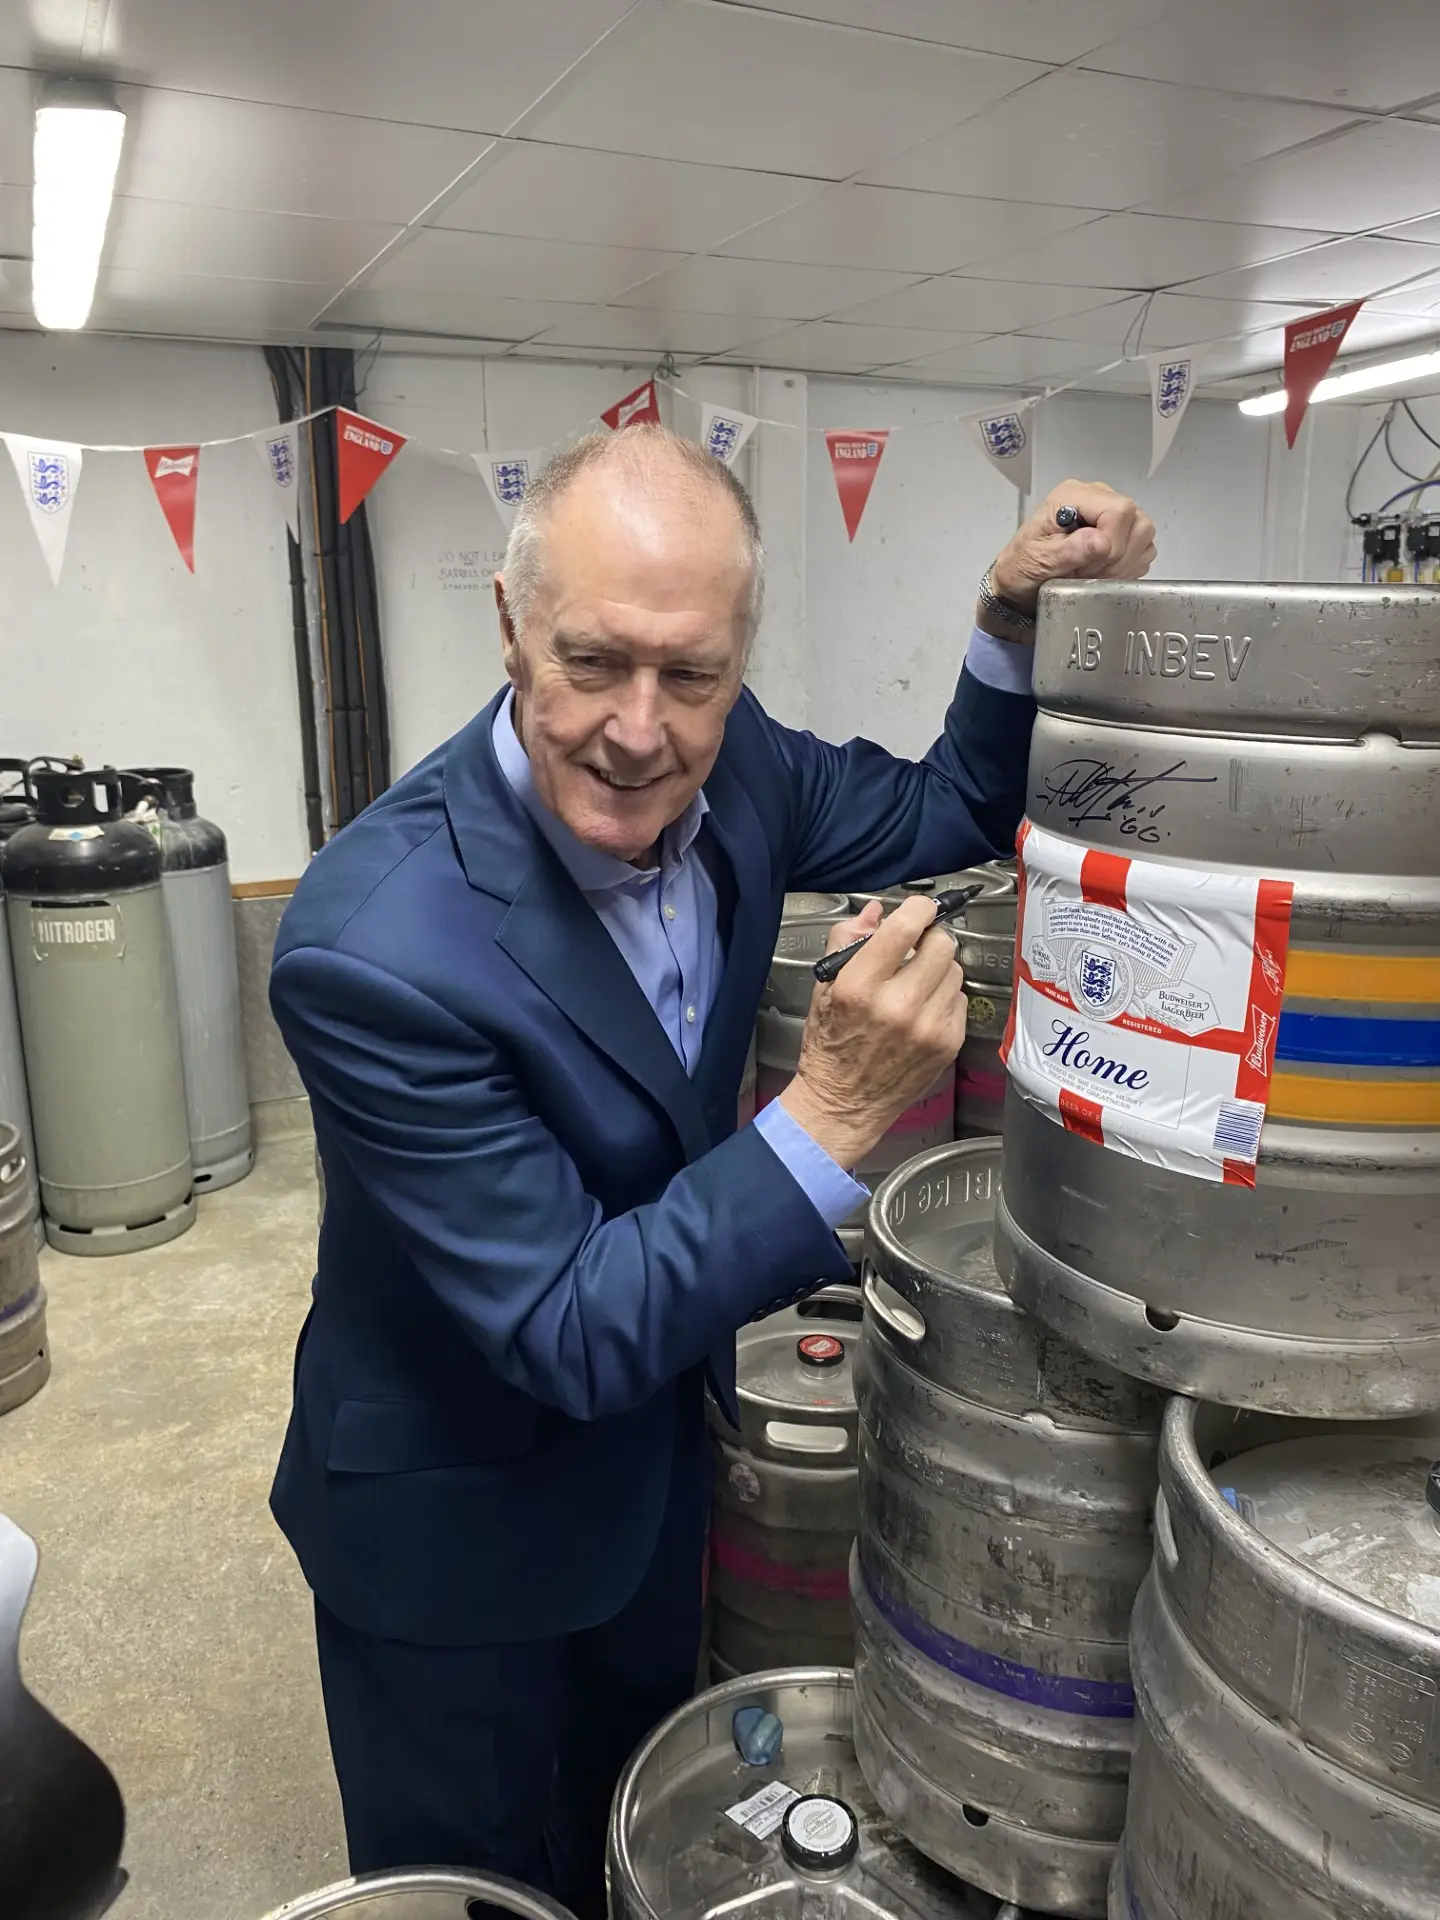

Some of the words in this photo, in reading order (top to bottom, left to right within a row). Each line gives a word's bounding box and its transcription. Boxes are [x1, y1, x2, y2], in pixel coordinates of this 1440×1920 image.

[1290, 329, 1330, 352] ENGLAND
[344, 429, 380, 452] ENGLAND
[459, 551, 479, 562] NOT
[1067, 627, 1102, 672] AB
[1124, 630, 1252, 682] INBEV
[38, 918, 116, 944] NITROGEN
[1094, 910, 1112, 920] blessed
[1112, 916, 1123, 924] this
[1123, 920, 1153, 937] Budweiser
[1153, 935, 1167, 946] with
[1167, 942, 1178, 952] the
[1101, 919, 1115, 928] 1966
[1130, 931, 1142, 940] Cup
[1113, 931, 1128, 940] raise
[1128, 937, 1139, 945] this
[1130, 945, 1146, 957] bring
[1056, 993, 1069, 1004] MARK
[1159, 990, 1204, 1010] BUDWEISER
[1161, 1001, 1186, 1017] LAGER
[1185, 1008, 1205, 1021] BEER
[1122, 1018, 1162, 1034] REGISTERED
[1250, 1013, 1267, 1069] Budweiser
[1043, 1019, 1149, 1090] Home
[1048, 1069, 1075, 1088] TOUCHED
[1076, 1083, 1085, 1092] BY
[1086, 1089, 1131, 1109] GREATNESS
[1068, 1073, 1077, 1081] BY
[1077, 1077, 1089, 1087] SIR
[1090, 1083, 1114, 1097] GEOFF
[1115, 1093, 1145, 1107] HURST
[1060, 1098, 1079, 1113] BEER
[1081, 1108, 1093, 1116] OF
